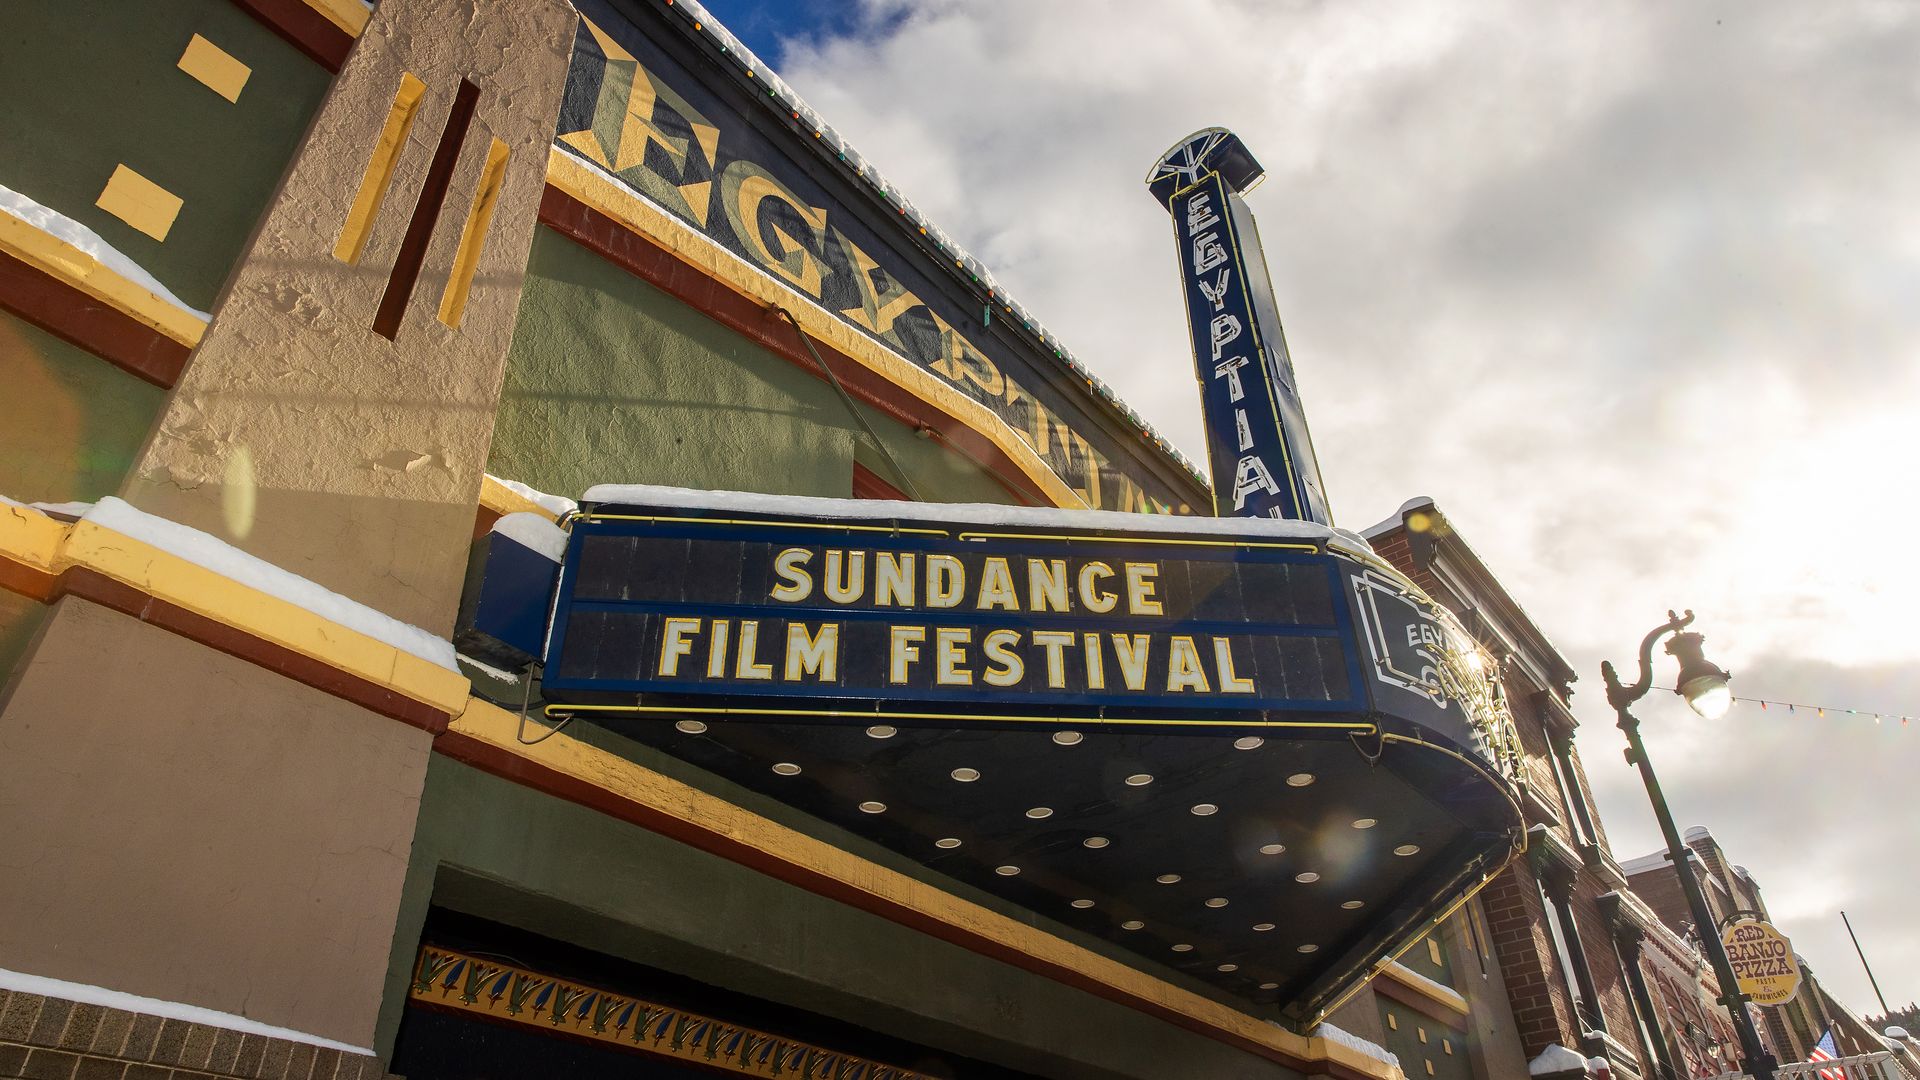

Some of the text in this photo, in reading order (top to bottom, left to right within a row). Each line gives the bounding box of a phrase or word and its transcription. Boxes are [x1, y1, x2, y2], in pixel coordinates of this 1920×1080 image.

[557, 12, 1172, 516] EGYPTI
[1187, 191, 1284, 520] EGYPTIA
[771, 547, 1164, 616] SUNDANCE
[657, 617, 1256, 694] FILM FESTIVAL
[1734, 925, 1765, 942] RED
[1725, 940, 1786, 962] BANJO
[1731, 957, 1793, 979] PIZZA
[1755, 977, 1776, 985] PASTA
[1752, 988, 1788, 1000] SANDWICHES
